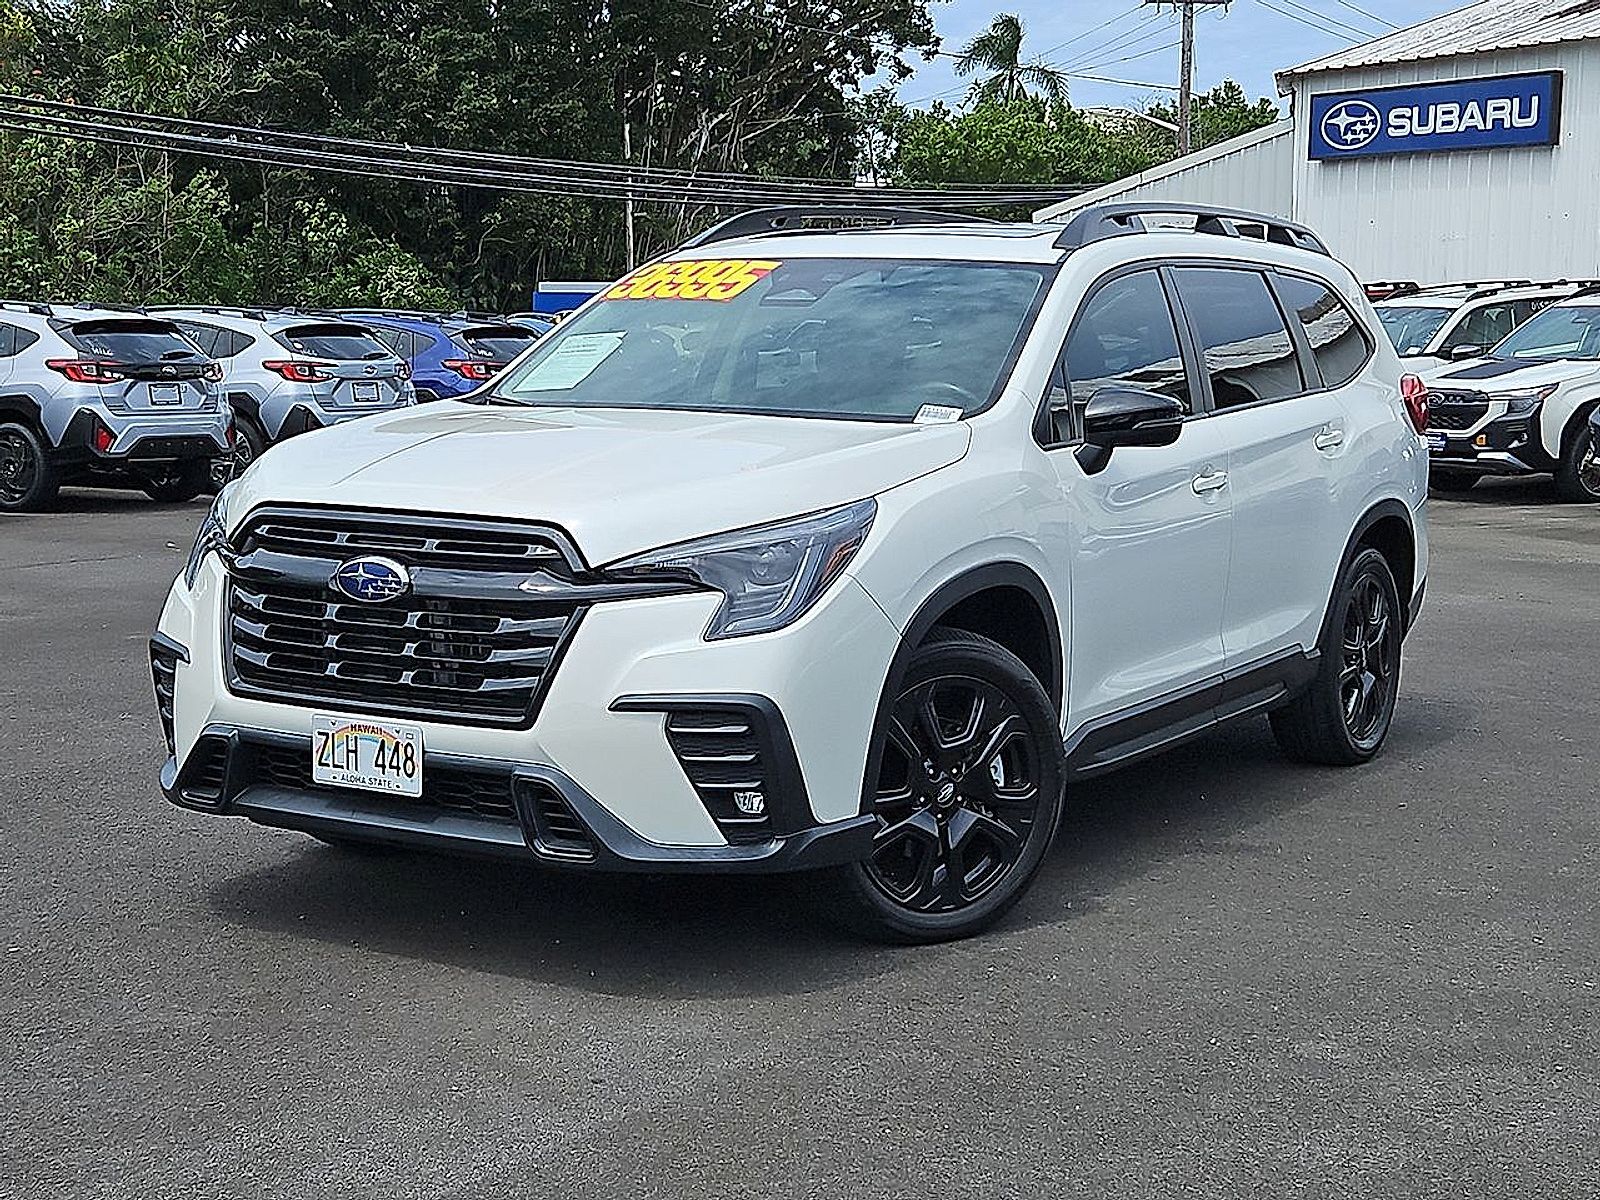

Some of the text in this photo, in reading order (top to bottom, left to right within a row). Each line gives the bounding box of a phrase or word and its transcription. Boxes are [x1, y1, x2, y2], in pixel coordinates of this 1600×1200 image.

[1387, 95, 1539, 137] SUBARU
[605, 259, 783, 302] 36995
[350, 723, 383, 735] HAWAII
[317, 730, 416, 779] ZLH 448
[340, 773, 392, 789] ALOHA STATE
